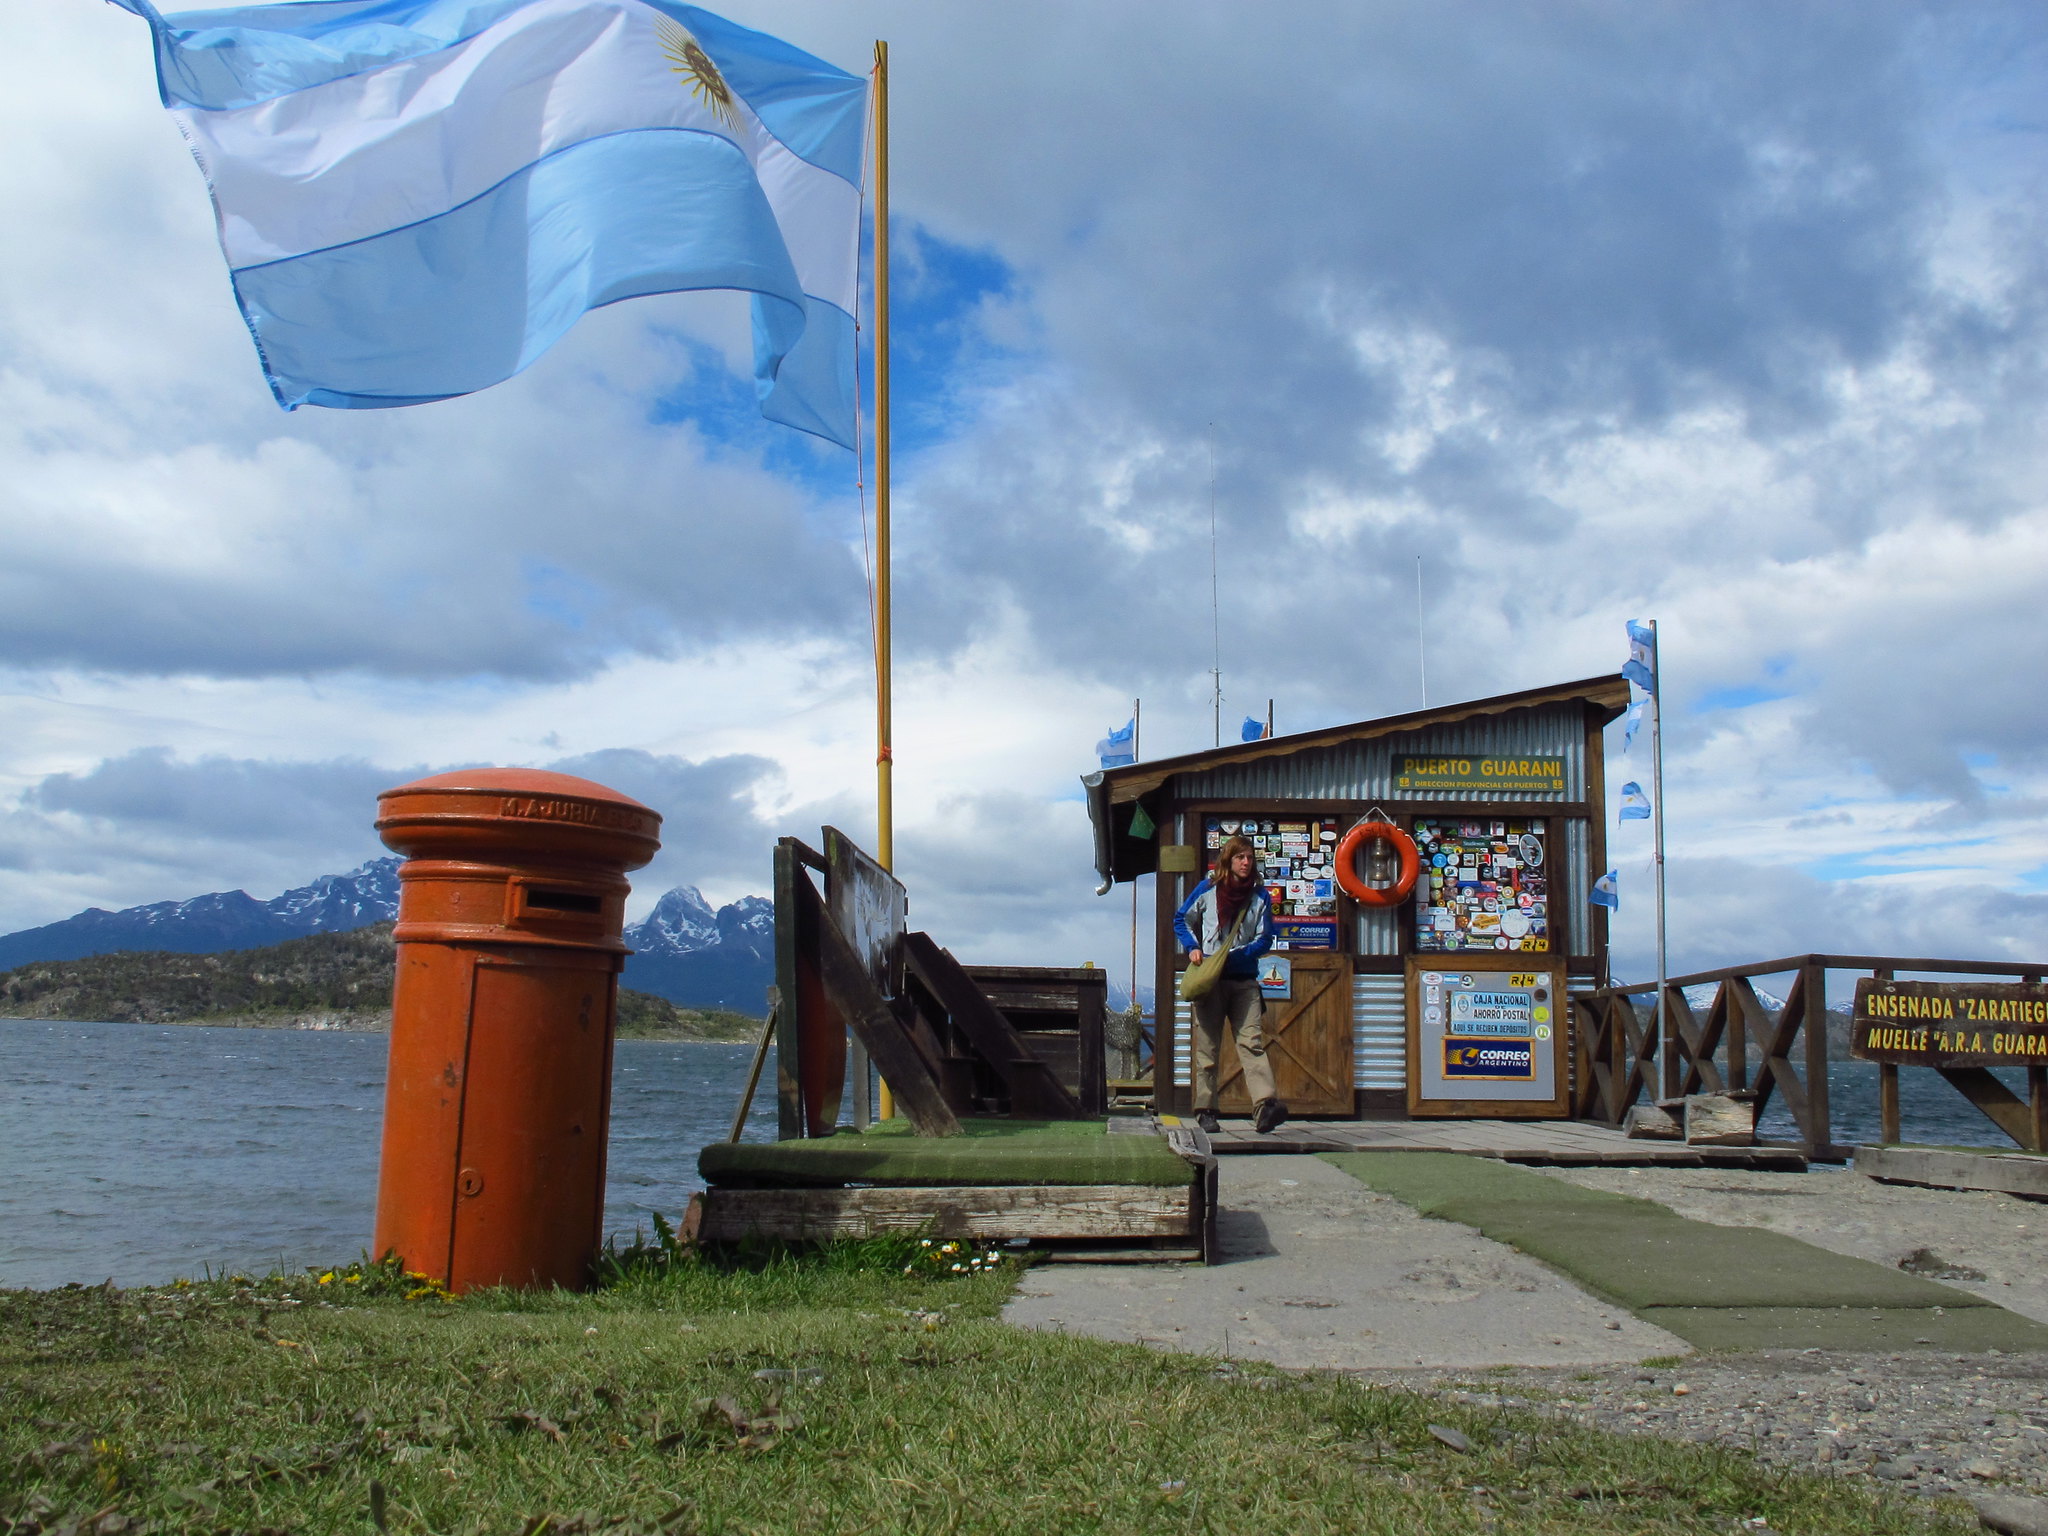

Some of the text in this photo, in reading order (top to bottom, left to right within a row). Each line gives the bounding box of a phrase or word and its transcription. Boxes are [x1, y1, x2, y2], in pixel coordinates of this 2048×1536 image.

[1404, 759, 1561, 777] PUERTO GUARANI
[1474, 995, 1527, 1006] CAJA NACIONAL
[1474, 1009, 1528, 1020] AHORRO POSTAL
[1868, 995, 2048, 1023] ENSENADA "ZARATIEG
[1453, 1024, 1527, 1034] AQUI SE RECIBEN DEPOSITOS
[1868, 1028, 1927, 1051] MUELLE
[1479, 1049, 1530, 1061] CORREO
